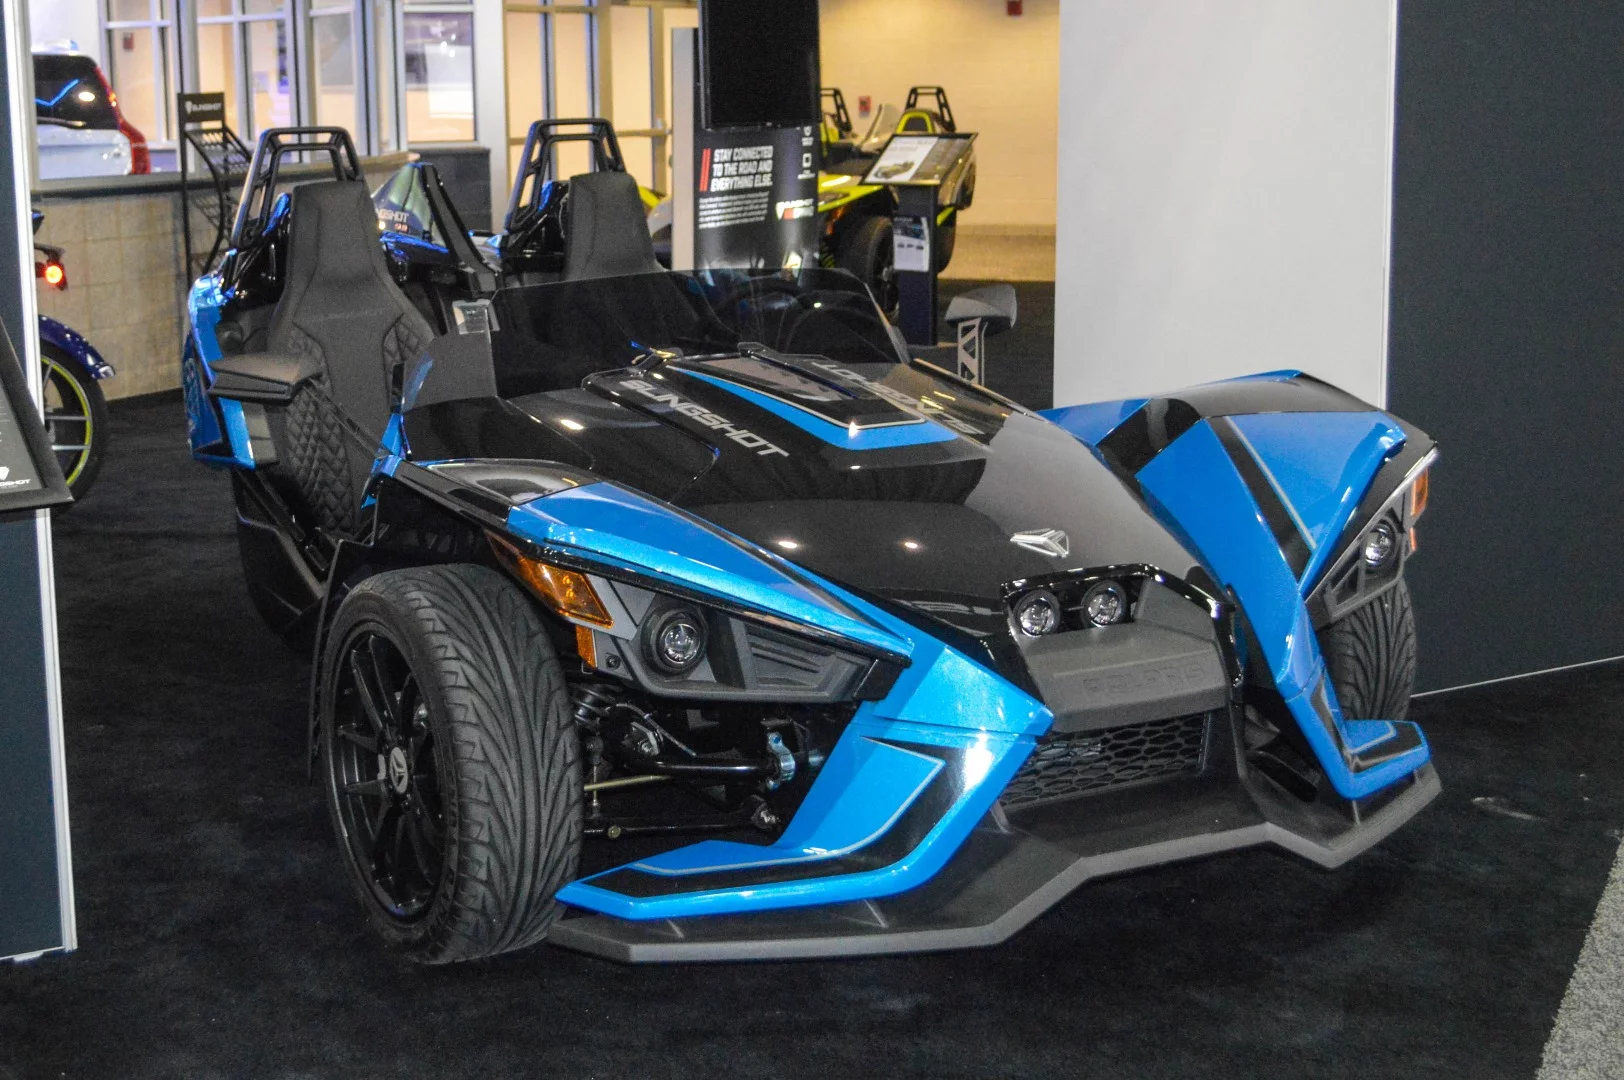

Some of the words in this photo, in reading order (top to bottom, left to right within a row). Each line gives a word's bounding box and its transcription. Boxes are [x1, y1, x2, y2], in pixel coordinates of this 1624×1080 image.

[713, 148, 733, 162] STAY
[733, 145, 773, 161] CONNECTED
[713, 163, 723, 177] TO
[724, 162, 738, 176] THE
[738, 160, 758, 175] ROAD
[758, 159, 773, 173] AND
[710, 175, 754, 192] EVERYTHING
[618, 379, 791, 458] SLINGSHOT
